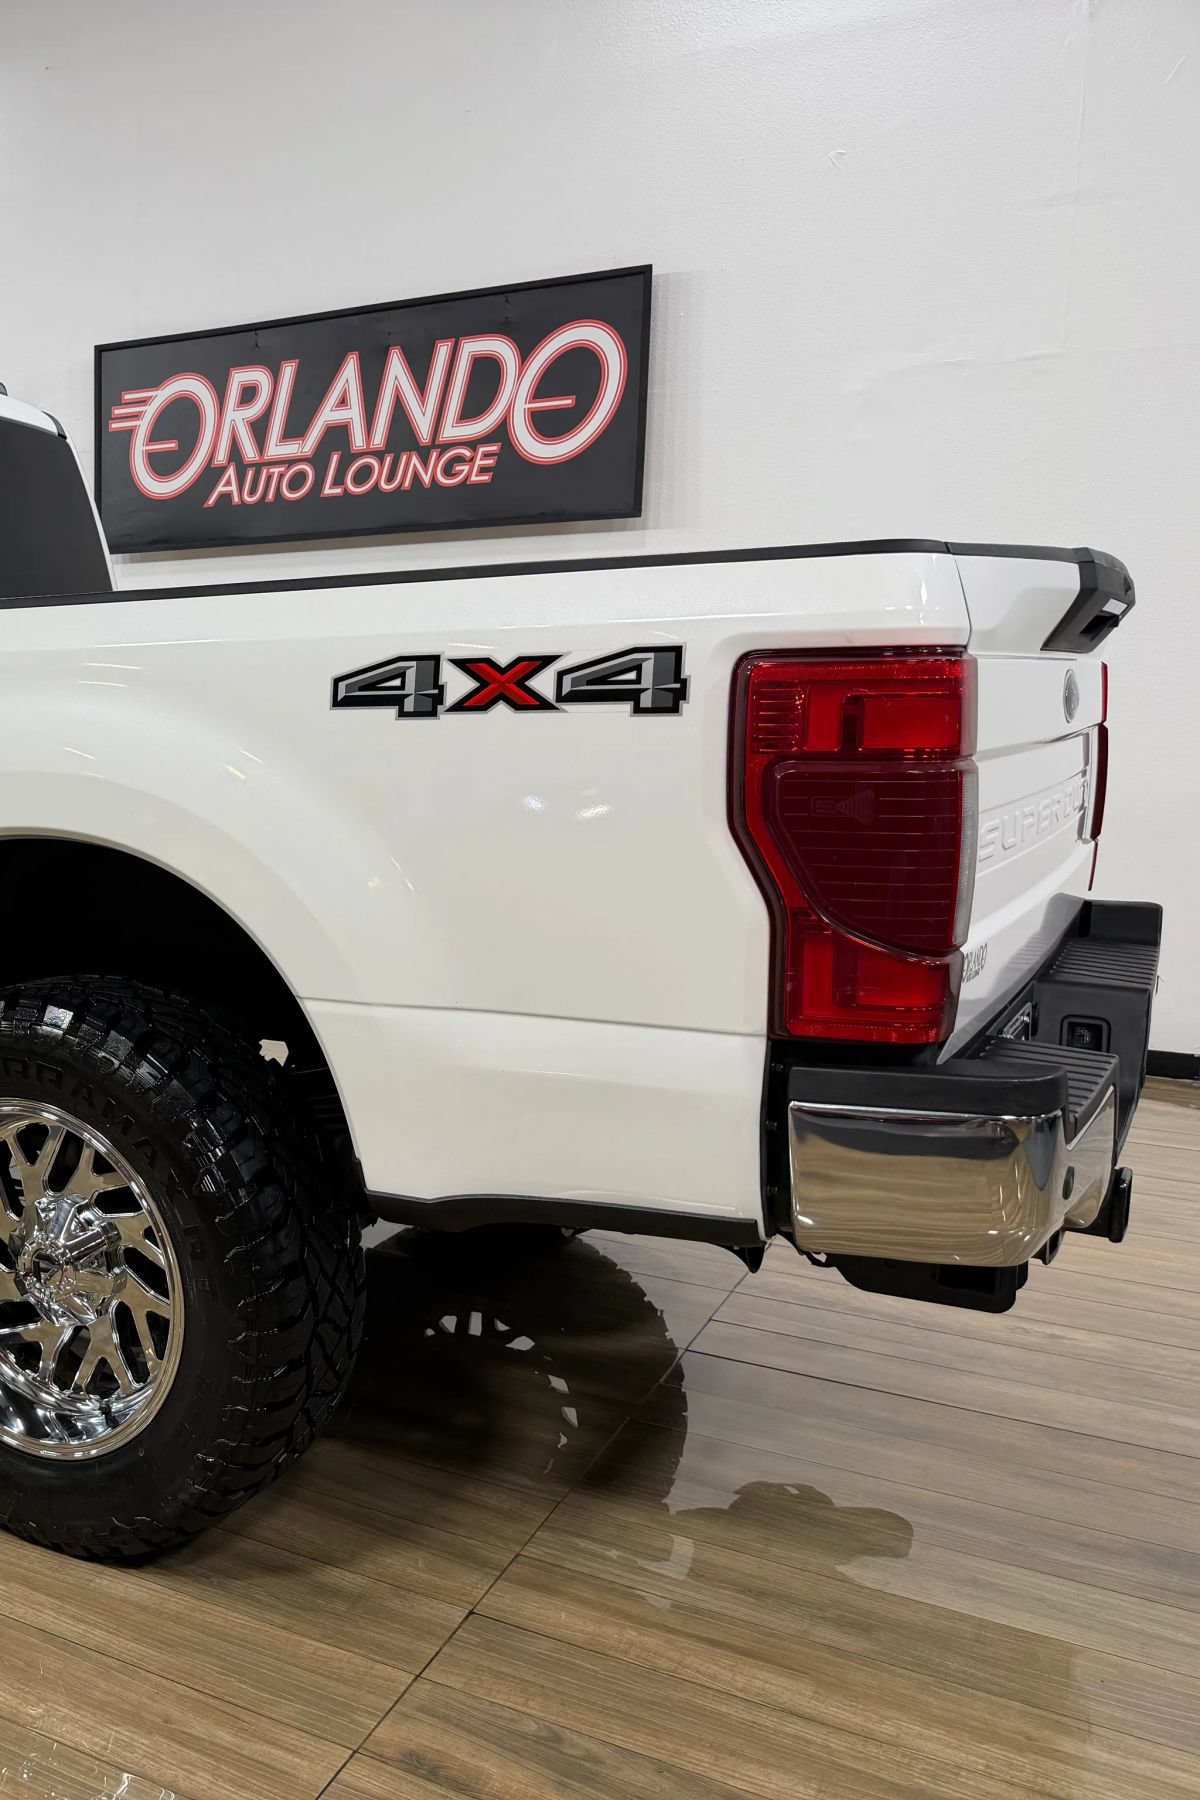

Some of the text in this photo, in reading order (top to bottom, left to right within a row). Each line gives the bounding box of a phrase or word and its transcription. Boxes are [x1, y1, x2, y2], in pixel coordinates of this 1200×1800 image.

[109, 318, 628, 500] ORLANDO
[203, 443, 500, 507] AUTO LOUNGE
[978, 792, 1060, 862] SUPER
